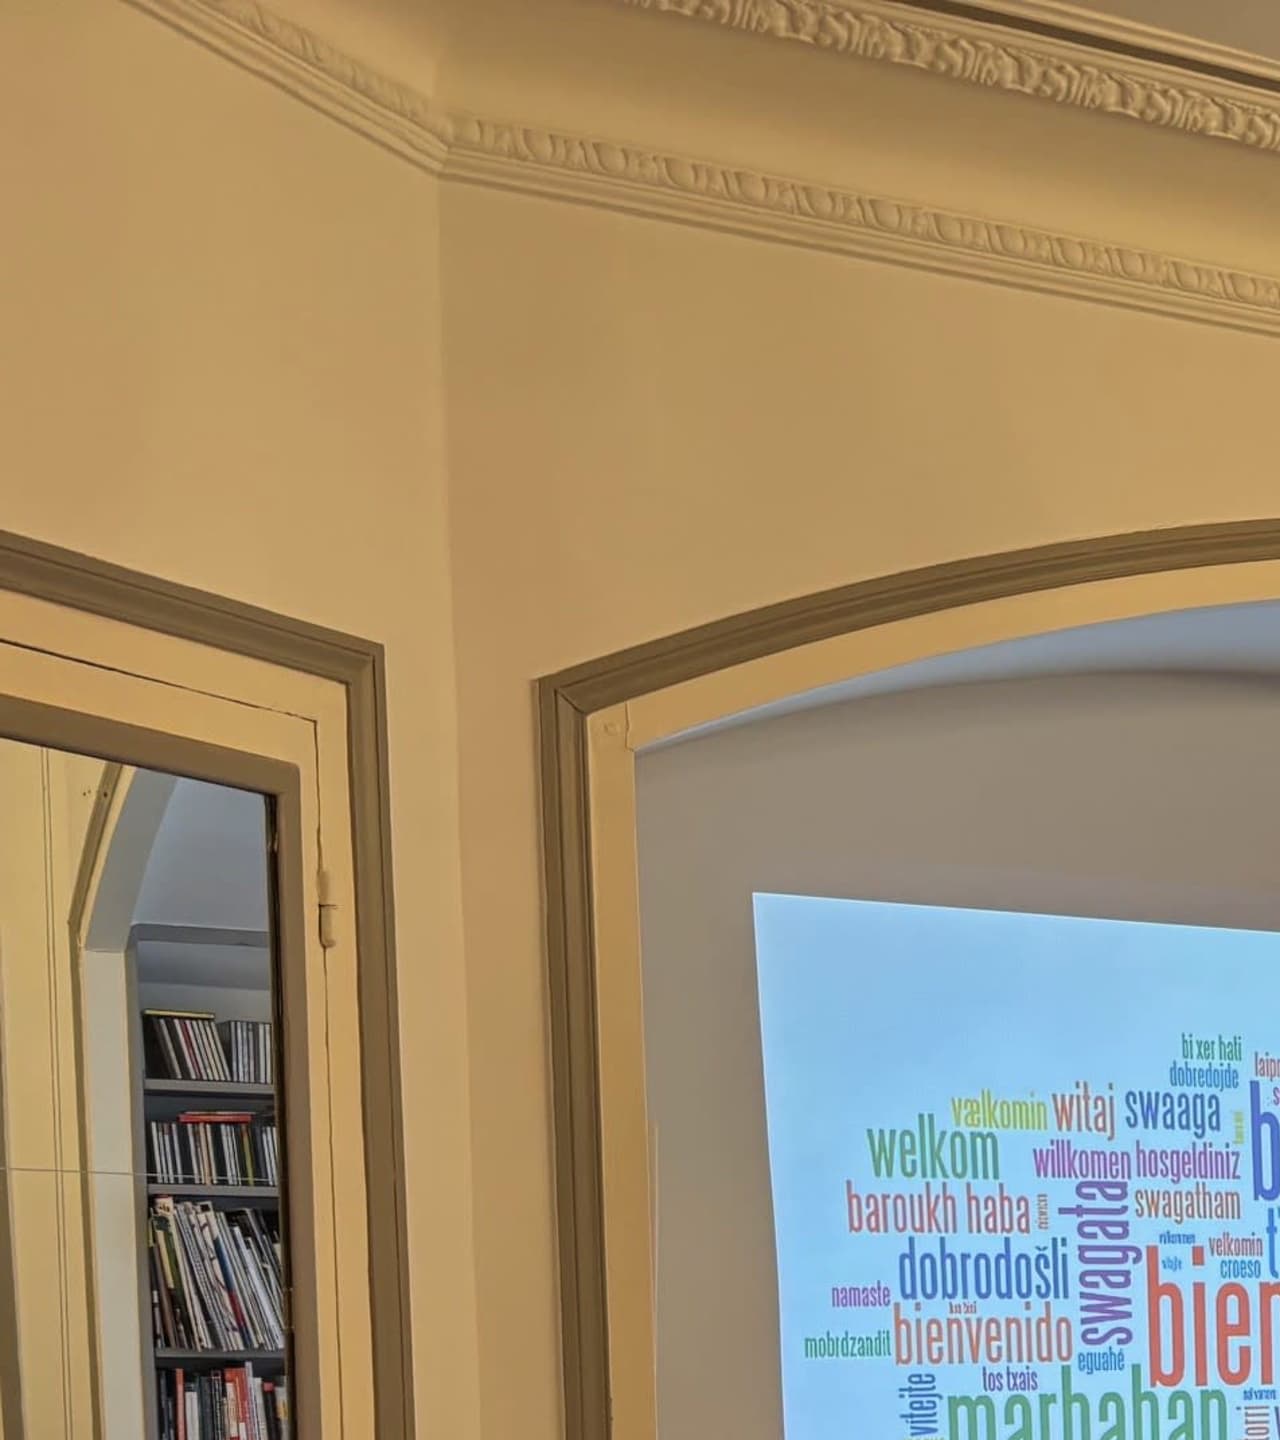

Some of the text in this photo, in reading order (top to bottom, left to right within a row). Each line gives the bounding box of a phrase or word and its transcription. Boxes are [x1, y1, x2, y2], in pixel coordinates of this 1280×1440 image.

[1181, 1033, 1195, 1060] bi
[1169, 1061, 1240, 1092] dobredojde
[1051, 1080, 1116, 1142] witaj
[1125, 1089, 1221, 1139] swaaga
[866, 1113, 1000, 1180] welkom
[1032, 1139, 1132, 1180] willkomen
[1136, 1140, 1241, 1184] hosgeldiniz
[845, 1179, 958, 1234] baroukh
[966, 1181, 1031, 1235] haba
[1135, 1181, 1241, 1224] swagatham
[1058, 1180, 1143, 1346] swagata
[1208, 1231, 1264, 1258] velkomin
[899, 1236, 1070, 1301] dobrodošli
[1220, 1259, 1262, 1280] croeso
[831, 1280, 891, 1308] namaste
[804, 1329, 892, 1360] mobrdzandit
[893, 1301, 1074, 1366] bienvenido
[982, 1366, 1038, 1392] tos txais
